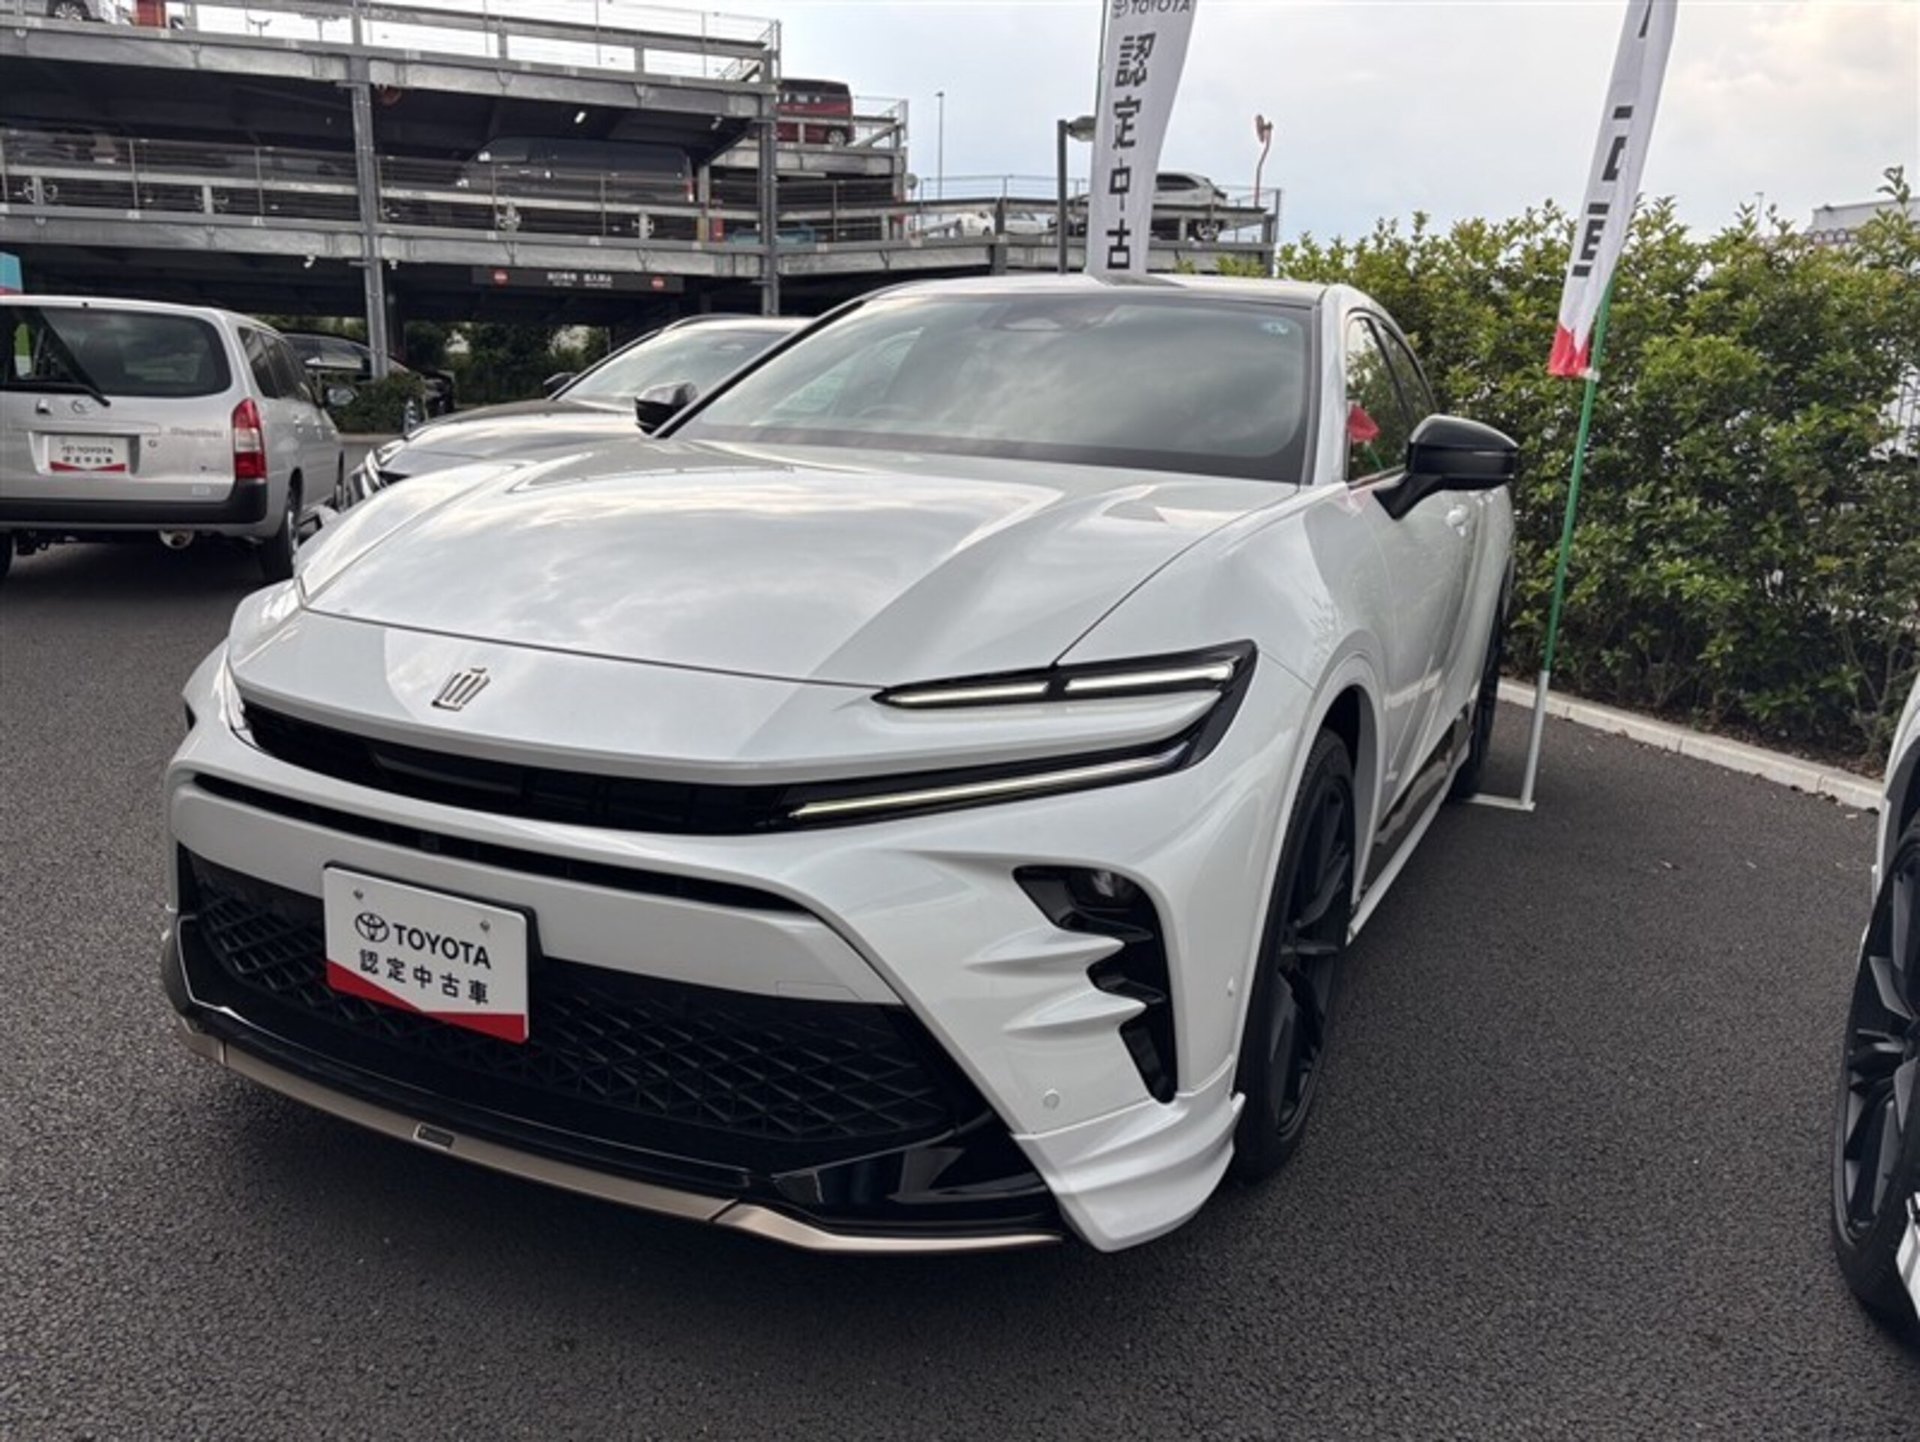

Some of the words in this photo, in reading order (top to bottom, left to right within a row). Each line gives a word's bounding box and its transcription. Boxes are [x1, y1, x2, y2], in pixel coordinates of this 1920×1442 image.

[393, 923, 492, 970] TOYOTA
[359, 949, 489, 1005] 認定中古車
